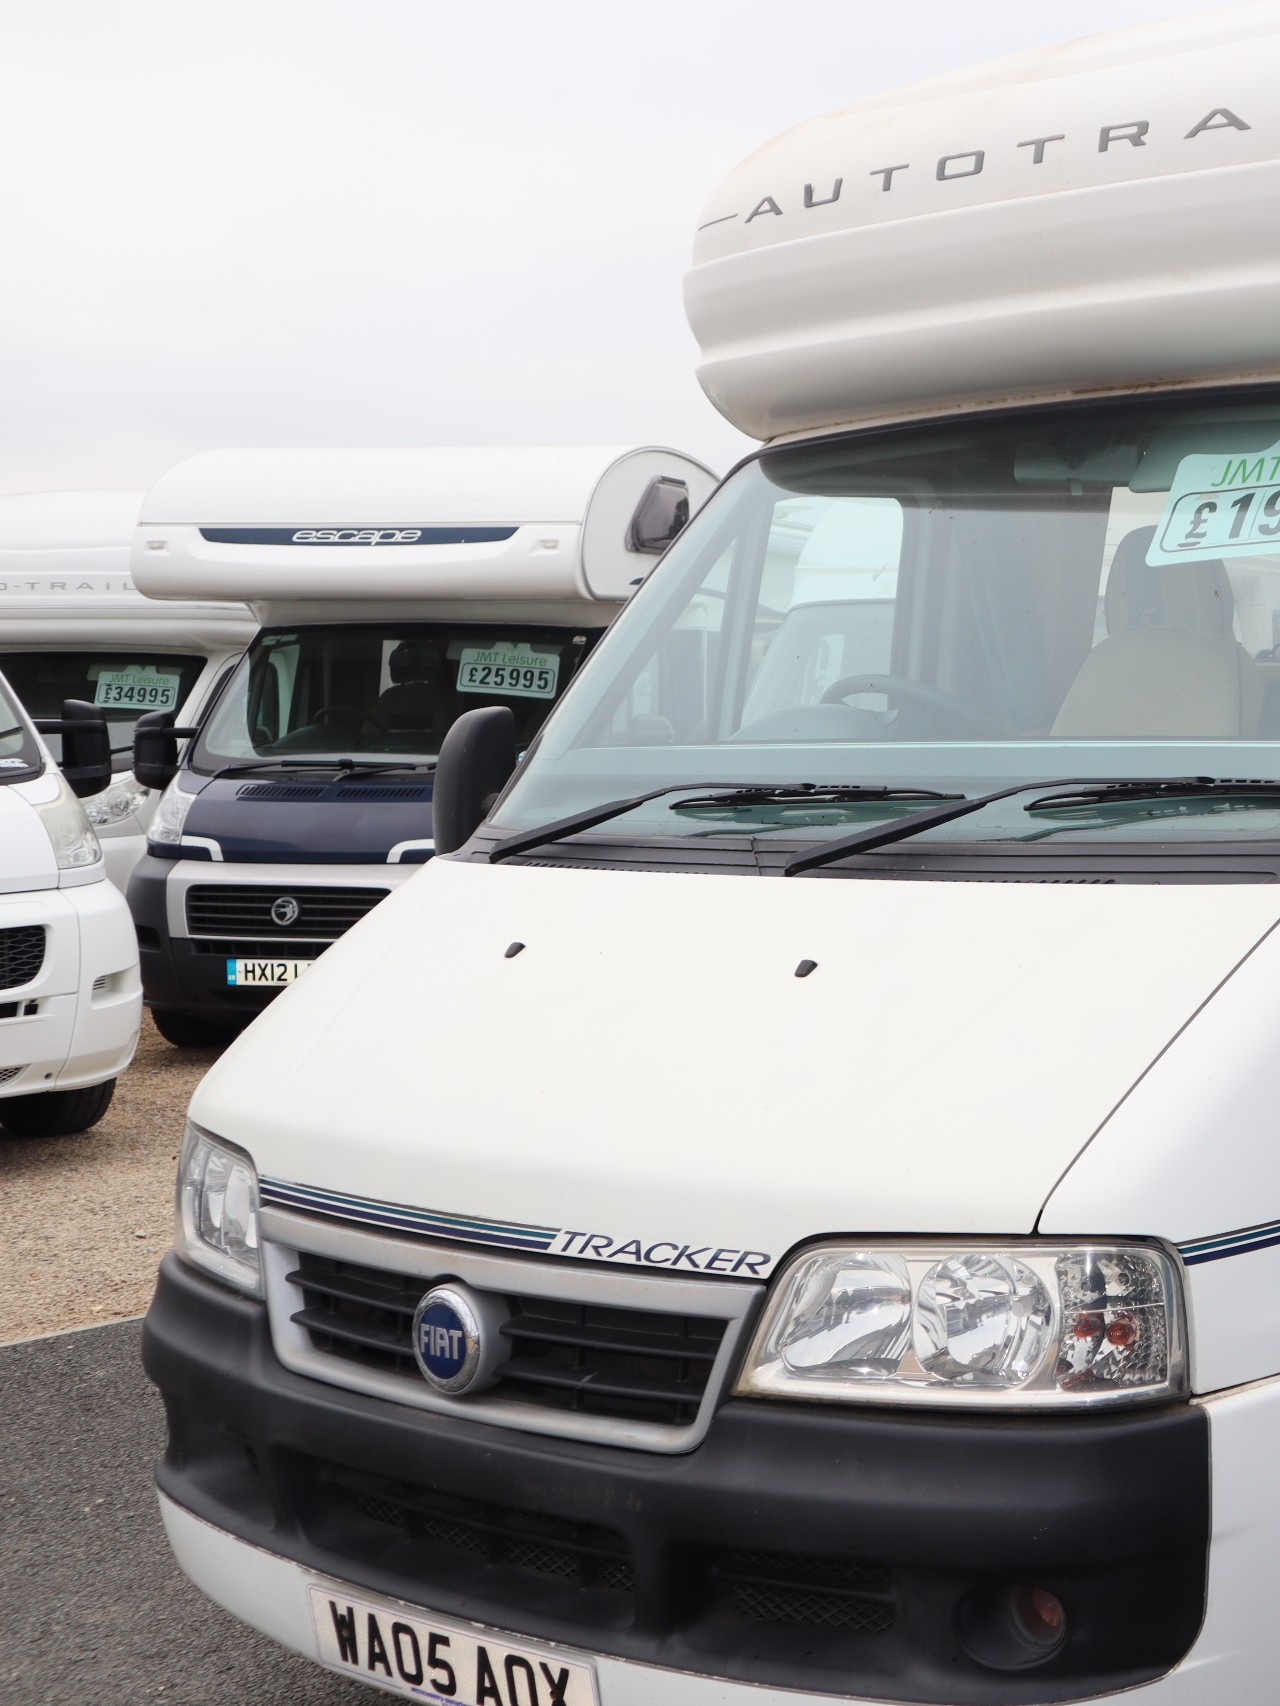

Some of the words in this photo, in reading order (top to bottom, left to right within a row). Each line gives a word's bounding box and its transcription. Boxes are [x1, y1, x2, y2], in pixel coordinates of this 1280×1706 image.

[292, 530, 422, 546] escape
[474, 651, 501, 663] JMT
[503, 652, 547, 667] Leisure
[109, 674, 131, 683] JMT
[132, 674, 170, 685] Leisure
[468, 666, 549, 690] £25995
[104, 686, 171, 704] £34995
[244, 963, 288, 982] HX12
[561, 1230, 772, 1275] TRACKER
[419, 1322, 463, 1360] FIAT
[329, 1600, 457, 1697] WA05
[476, 1645, 570, 1706] AOX
